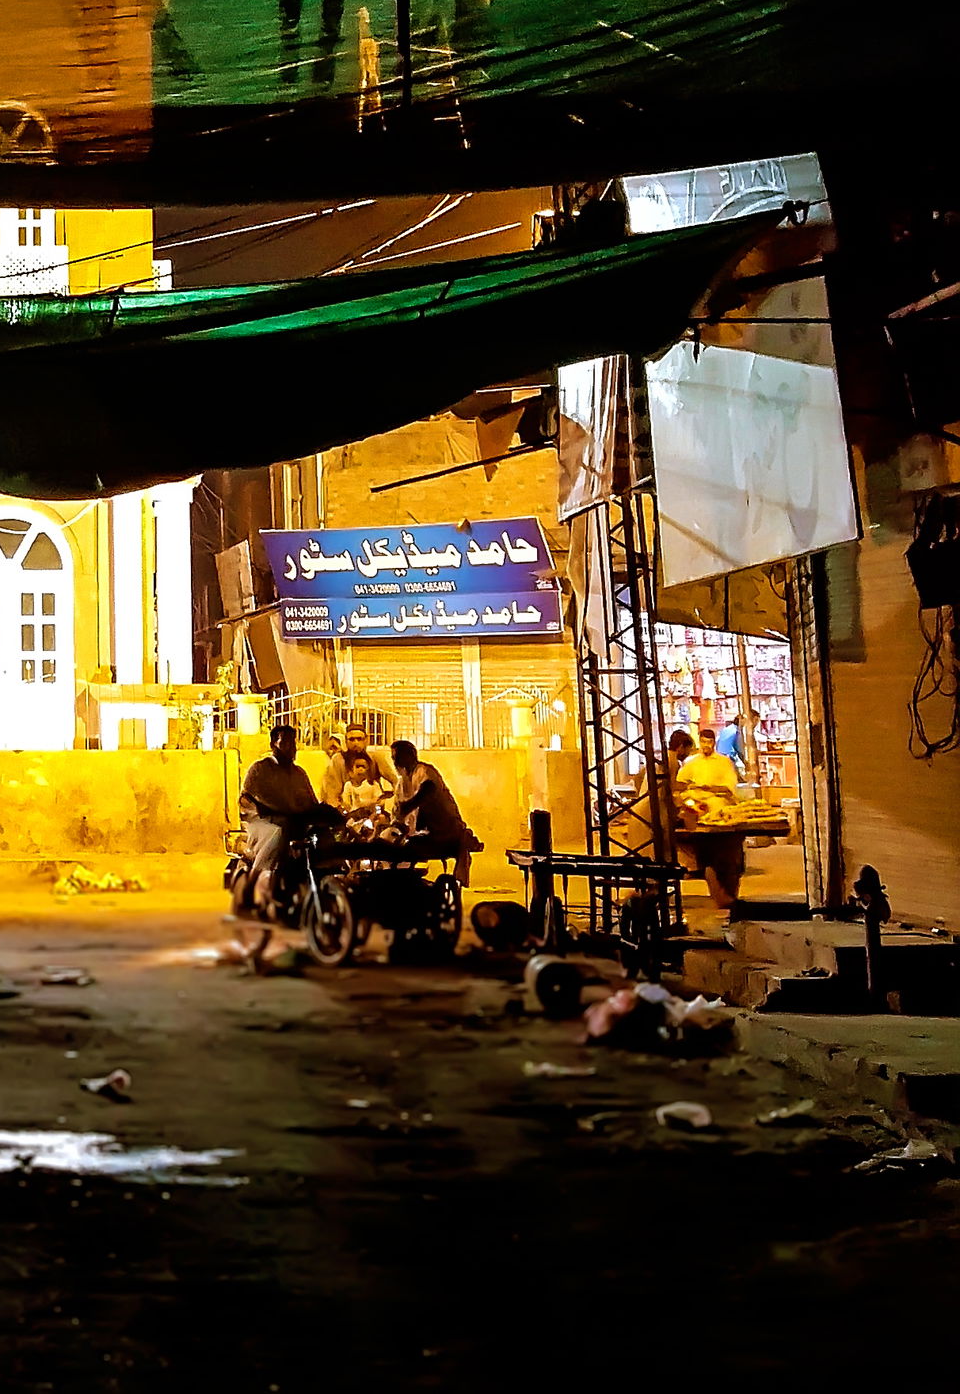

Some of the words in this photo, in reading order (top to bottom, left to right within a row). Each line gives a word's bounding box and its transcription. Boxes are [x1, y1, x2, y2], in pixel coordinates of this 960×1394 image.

[284, 538, 354, 580] سٹور
[357, 530, 462, 578] میڈیکل
[467, 530, 538, 566] حامد
[337, 605, 391, 633] سٹور
[393, 599, 478, 632] میڈیکل
[482, 600, 542, 624] حامد
